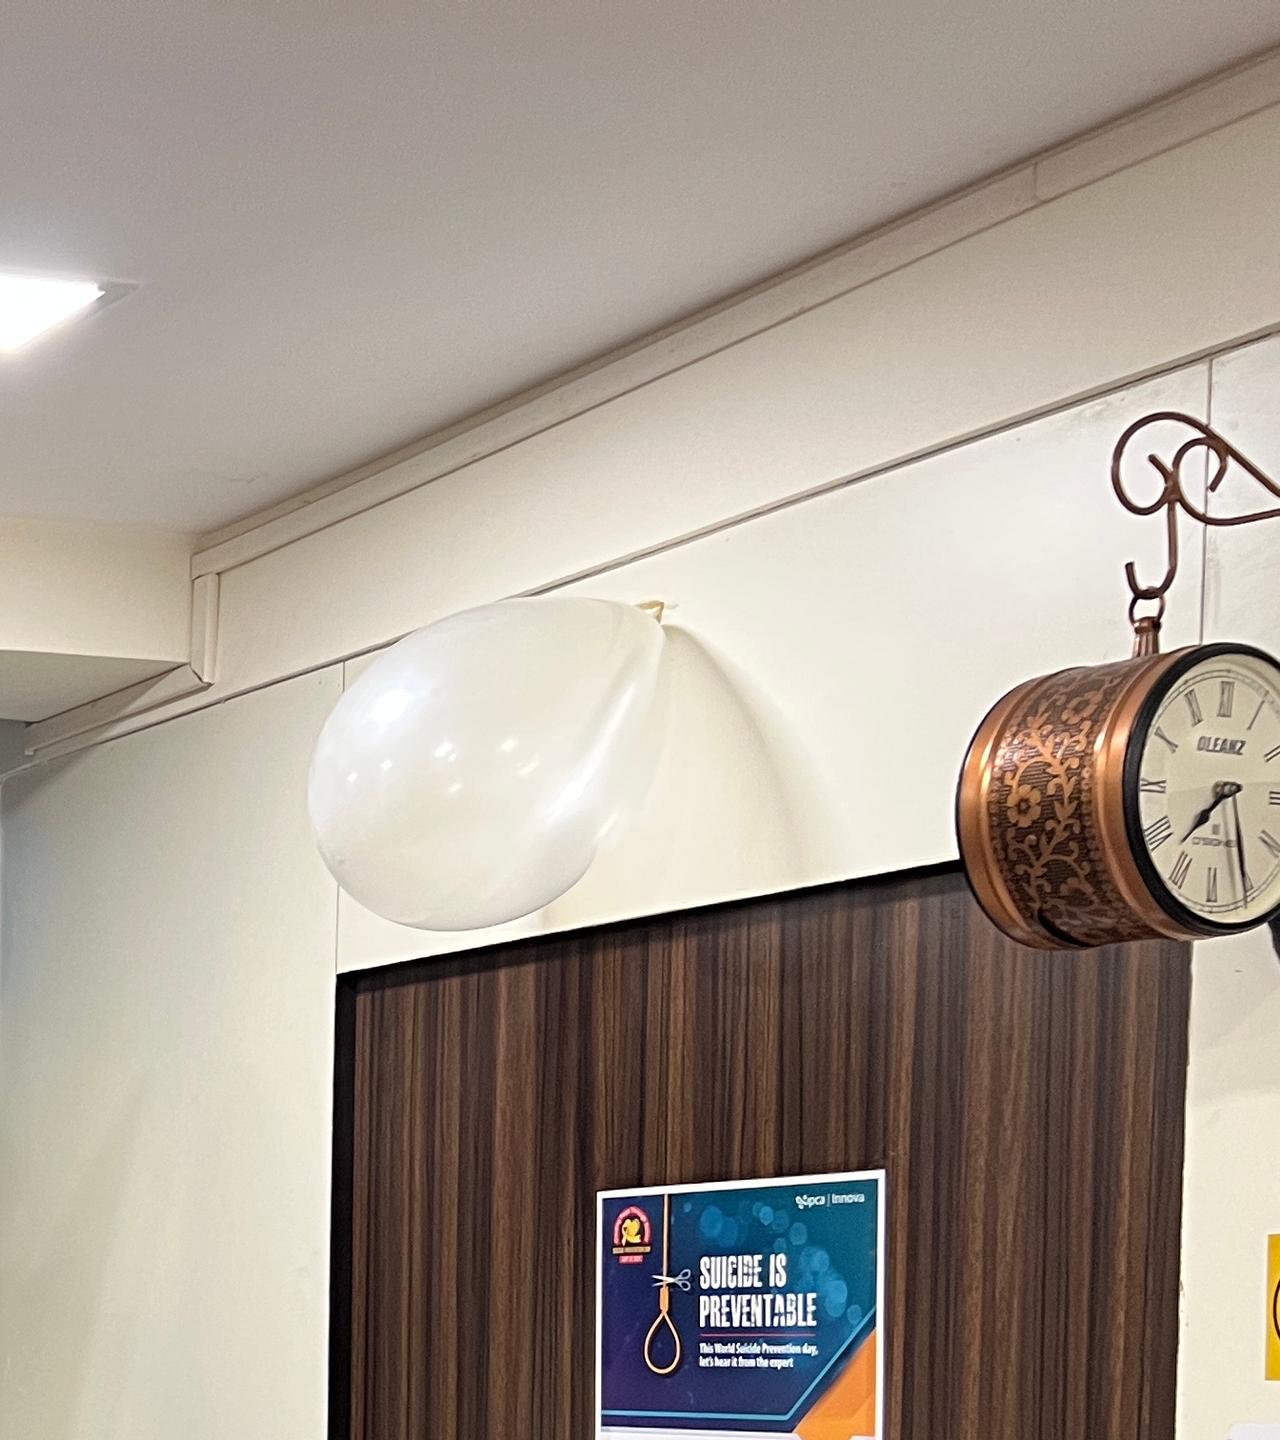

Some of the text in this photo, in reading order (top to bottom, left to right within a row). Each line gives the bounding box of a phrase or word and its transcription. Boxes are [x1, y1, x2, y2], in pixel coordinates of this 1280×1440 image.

[831, 1193, 865, 1204] Innova
[699, 1253, 787, 1290] SUICIDE IS
[699, 1293, 817, 1328] PREVENTABLE
[699, 1342, 819, 1357] This World Suicide Prevention day,
[714, 1356, 730, 1367] hear
[731, 1356, 738, 1367] it
[738, 1356, 756, 1367] from
[756, 1356, 769, 1368] the
[770, 1357, 794, 1370] expert
